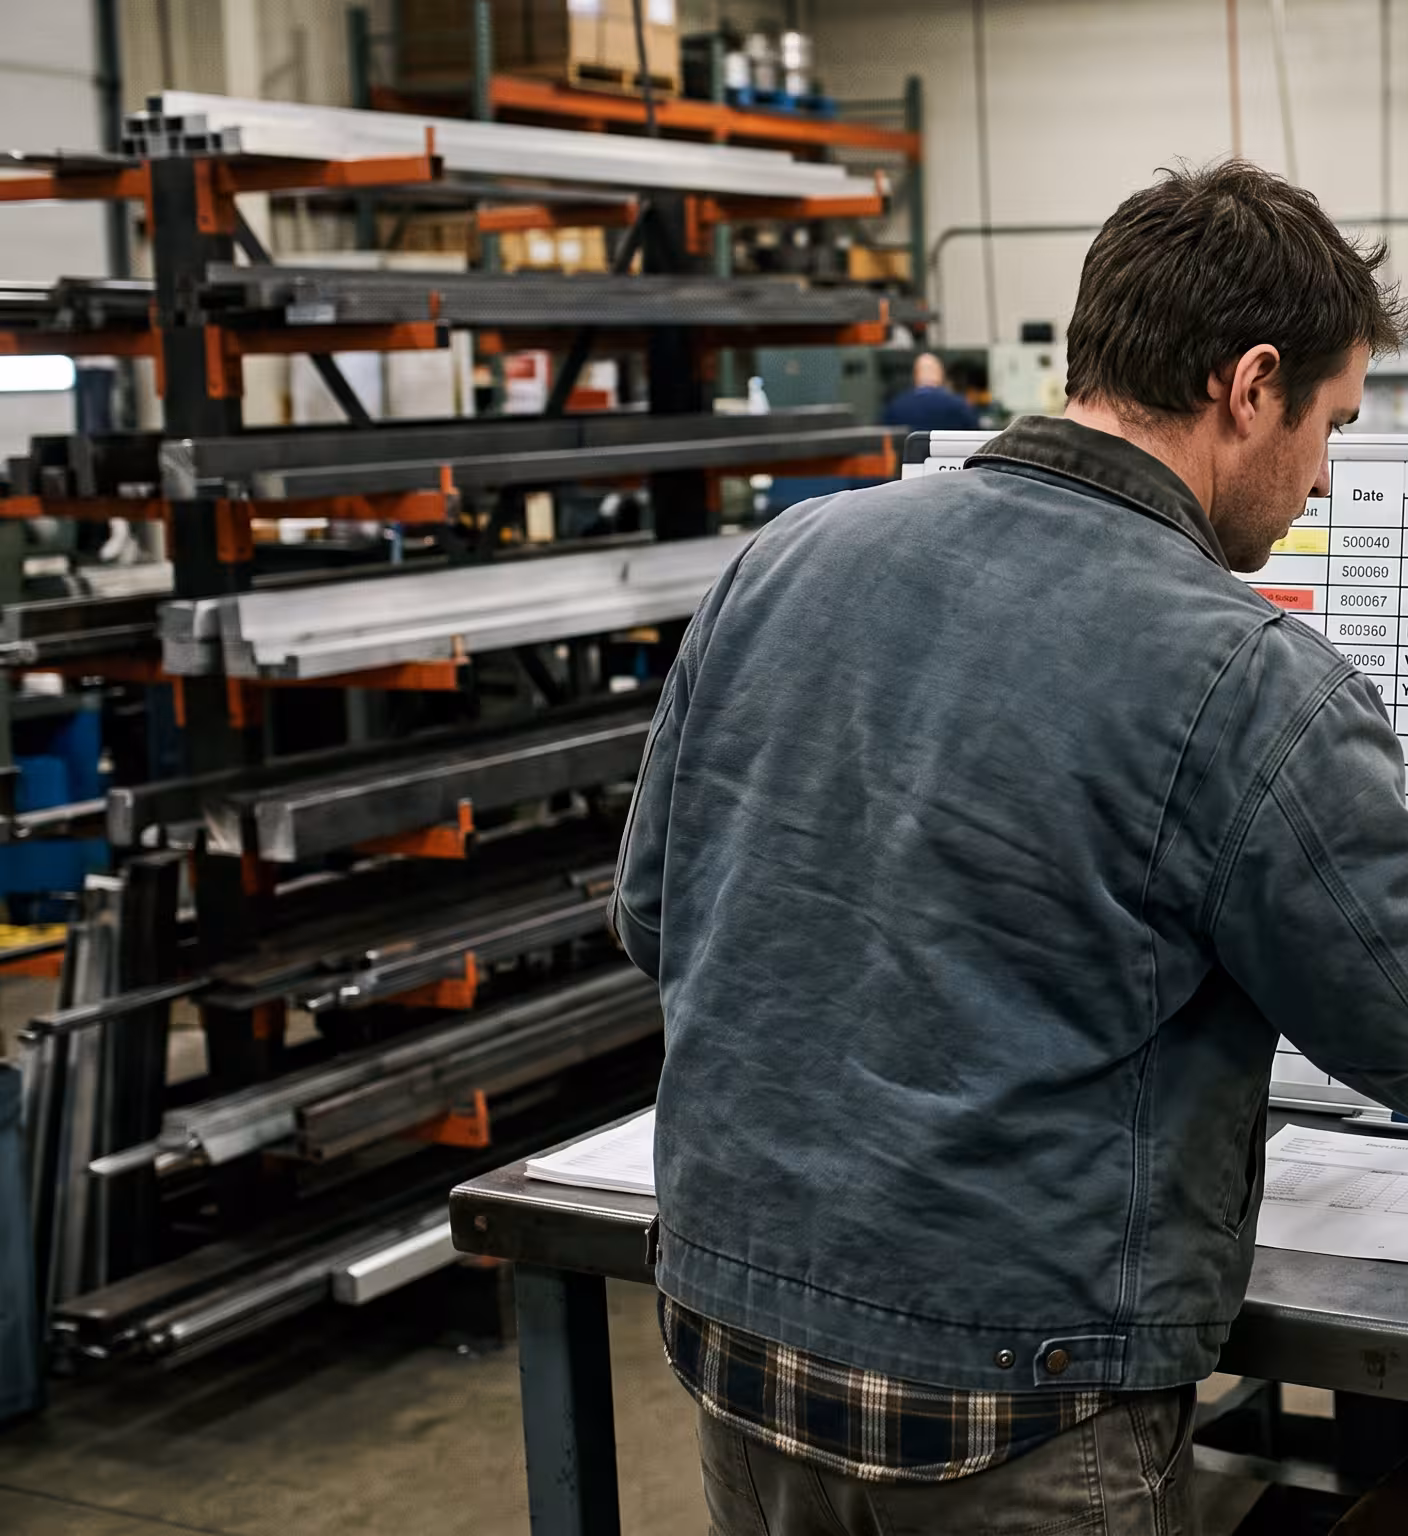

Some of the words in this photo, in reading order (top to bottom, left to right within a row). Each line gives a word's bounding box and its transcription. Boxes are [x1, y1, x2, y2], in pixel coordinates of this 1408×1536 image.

[1353, 489, 1383, 501] Date
[1343, 536, 1389, 548] 500040
[1341, 595, 1387, 607] 800067
